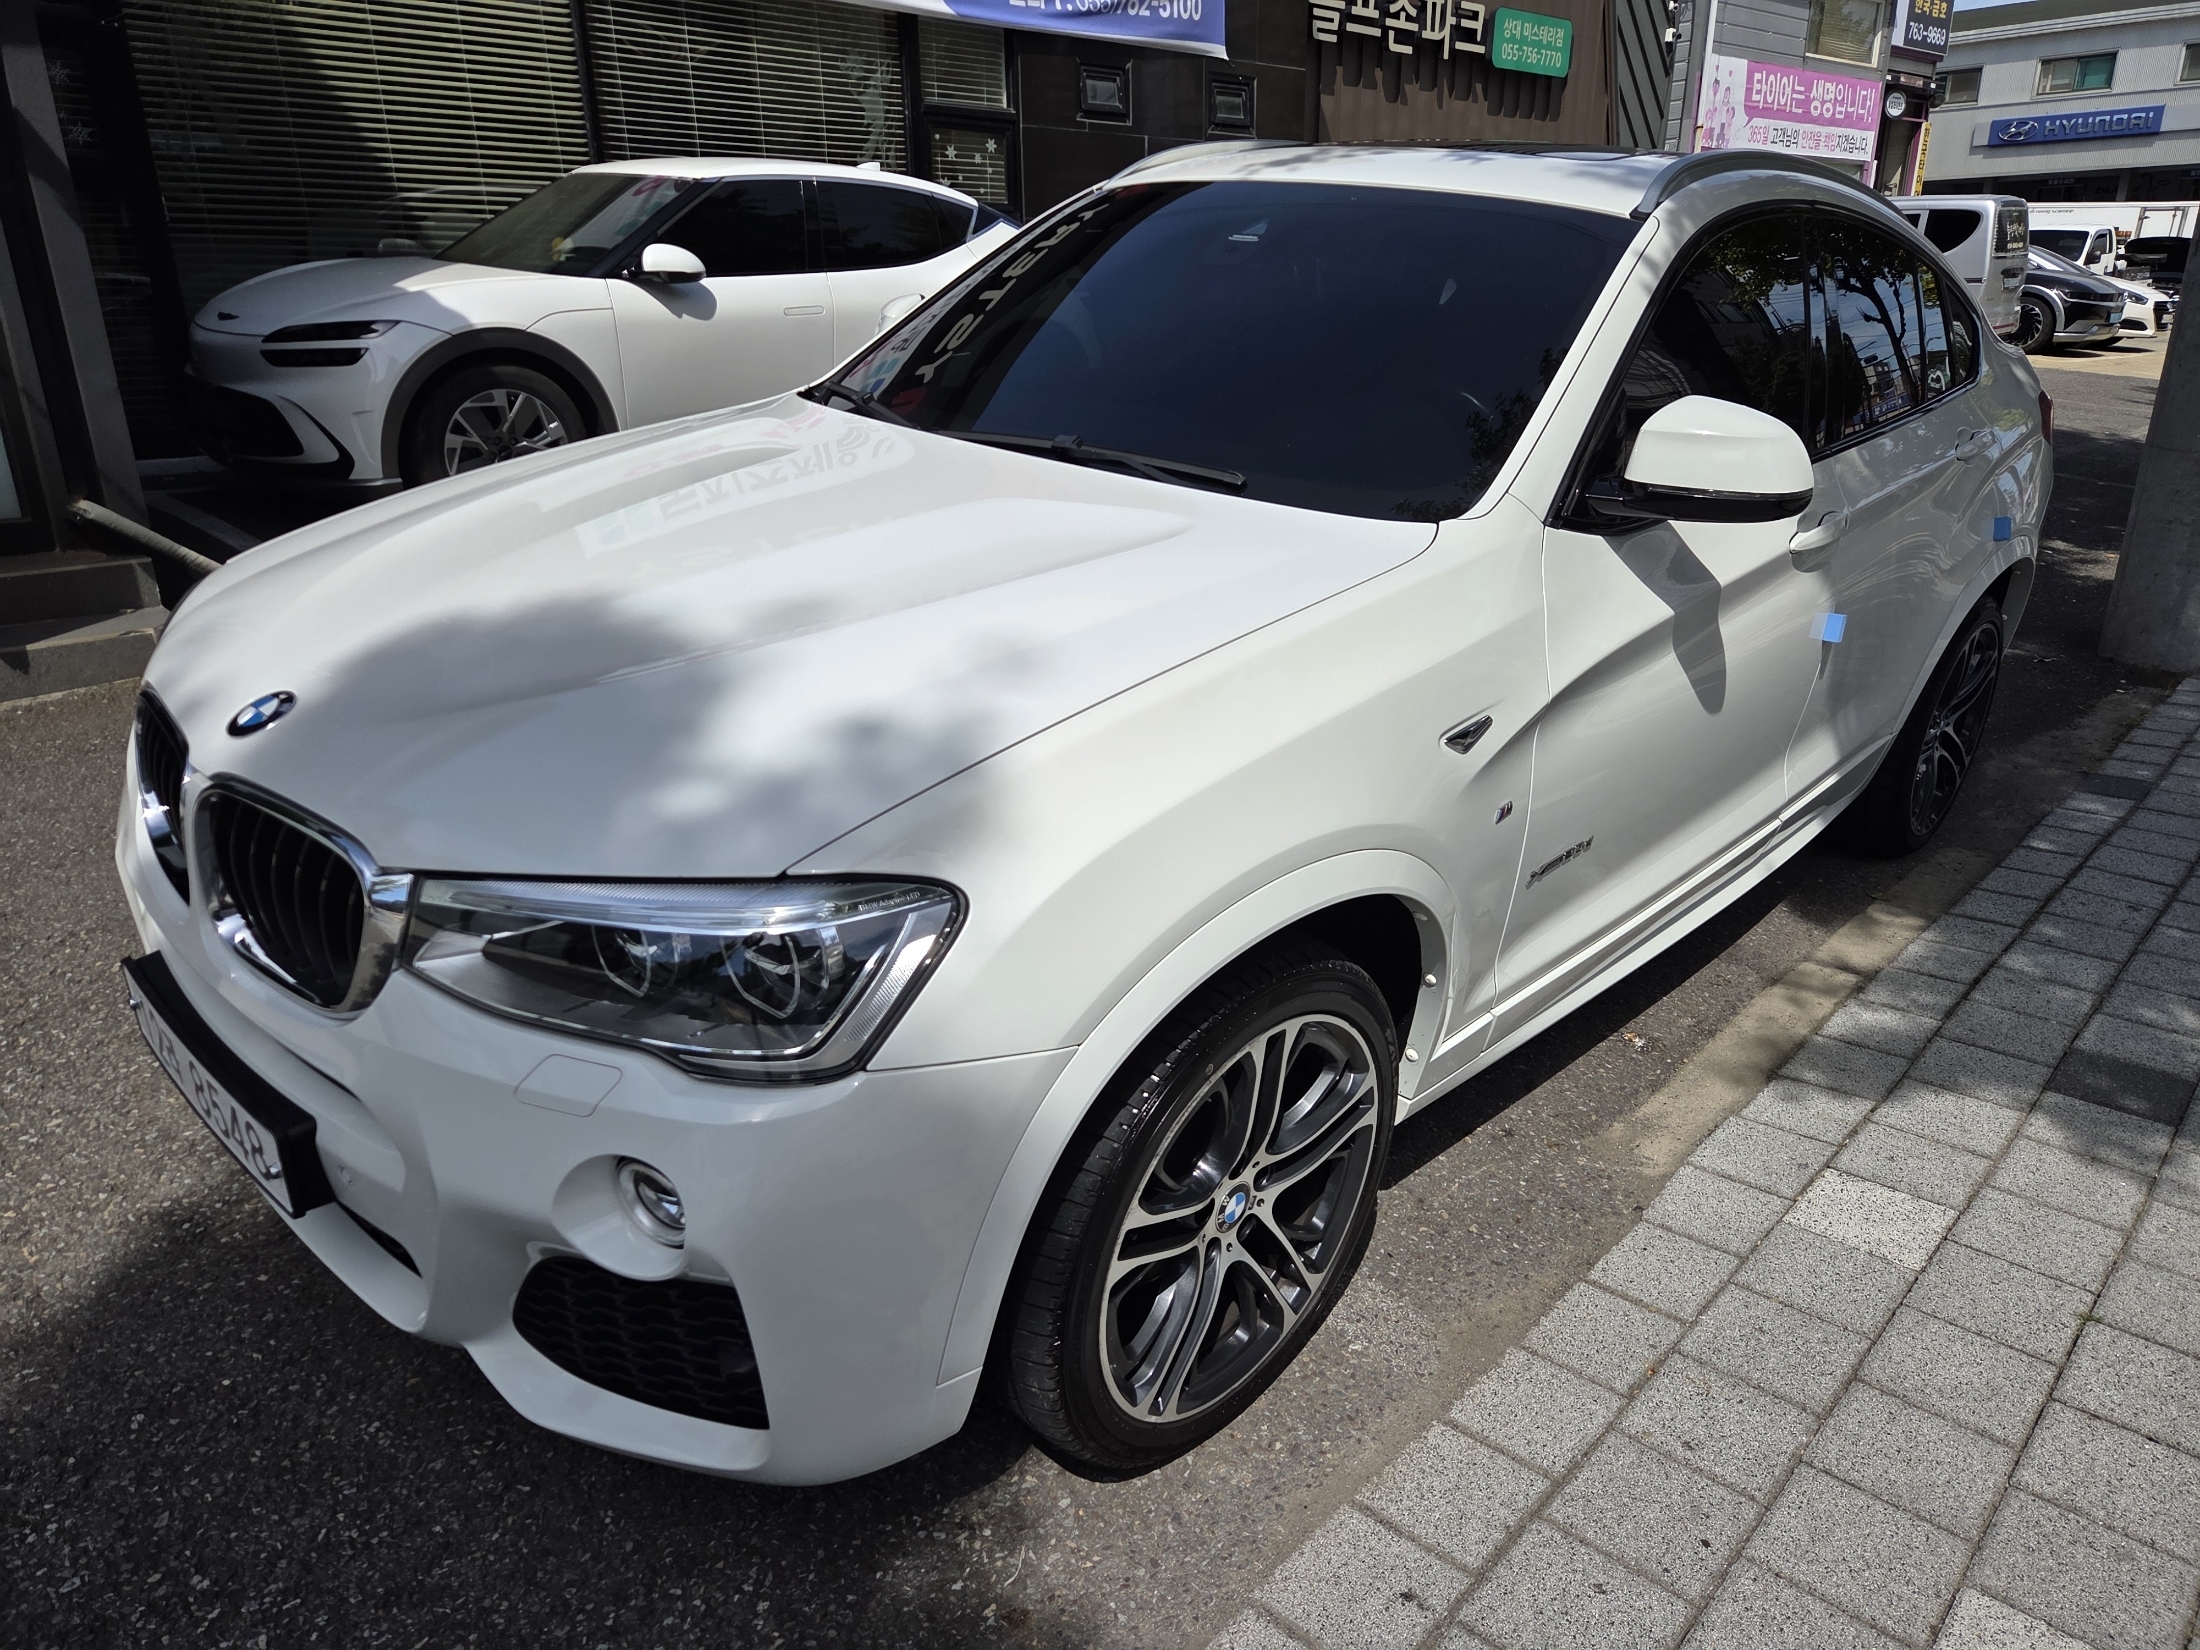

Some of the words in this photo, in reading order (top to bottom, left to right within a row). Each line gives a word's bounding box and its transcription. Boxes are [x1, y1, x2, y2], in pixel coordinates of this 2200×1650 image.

[1503, 17, 1522, 40] 상대
[1523, 22, 1565, 47] 미스테리점
[1908, 21, 1946, 46] 763-9669
[1501, 42, 1562, 68] 055-756-7770
[1751, 70, 1807, 114] 타이어는
[1810, 79, 1876, 123] 생명입니다!
[1747, 124, 1771, 146] 365일
[1769, 127, 1800, 149] 고객님의
[1800, 130, 1823, 151] 안전을
[2043, 111, 2155, 138] HYUNDAI
[188, 1059, 271, 1181] 8548
